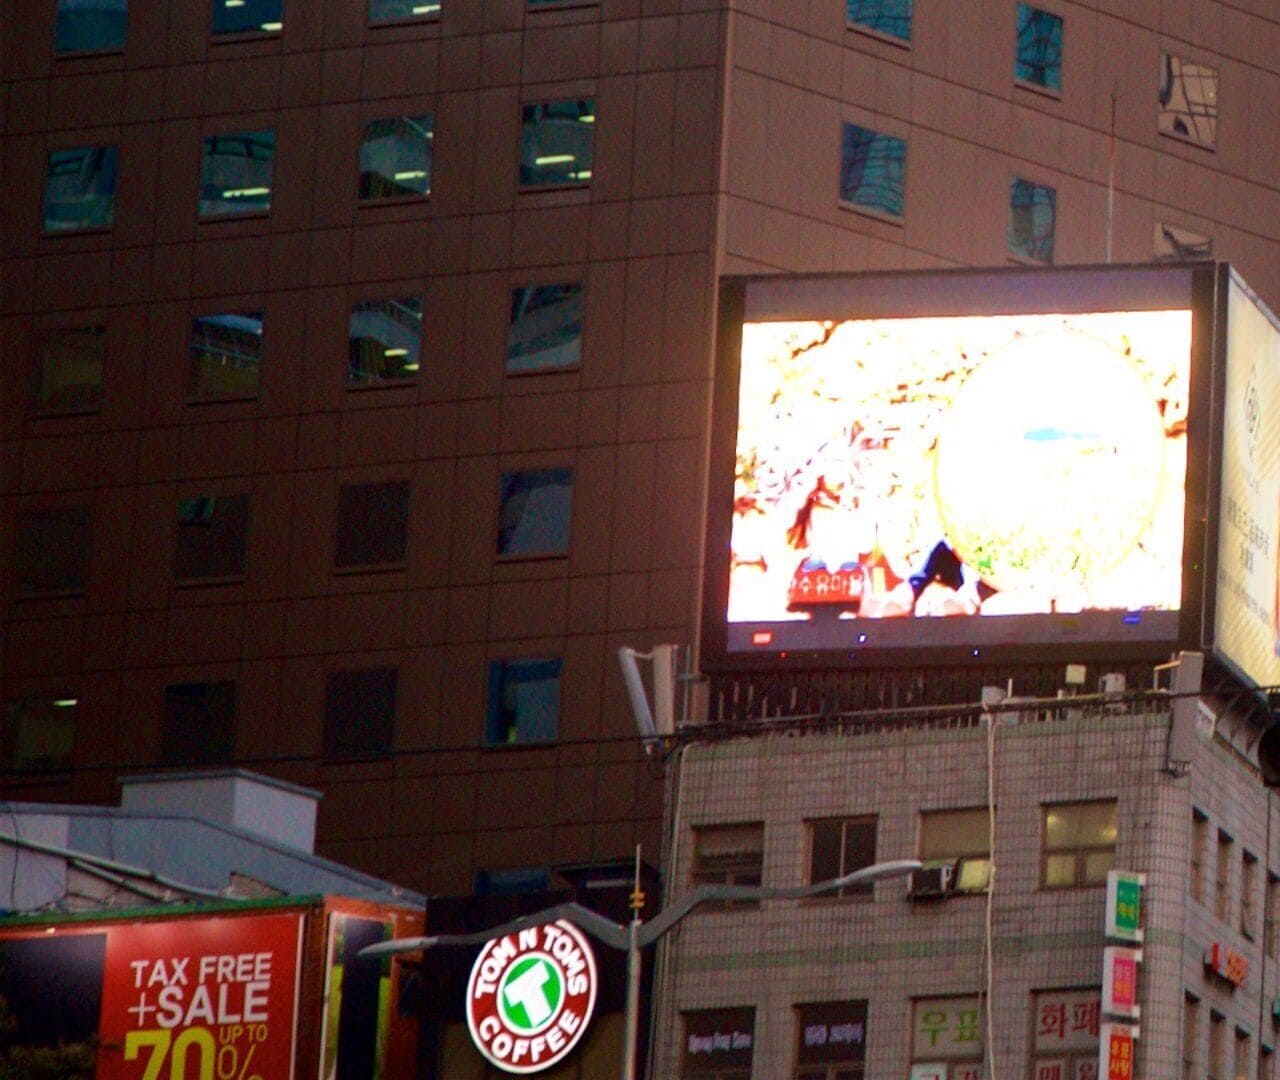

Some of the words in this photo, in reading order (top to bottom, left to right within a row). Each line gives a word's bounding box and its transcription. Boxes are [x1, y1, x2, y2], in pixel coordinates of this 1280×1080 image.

[130, 957, 190, 989] TAX
[199, 952, 273, 984] FREE
[474, 935, 518, 999] TOM
[518, 926, 538, 952] N
[543, 924, 588, 997] TOMS
[219, 1025, 243, 1044] UP
[248, 1023, 268, 1043] TO
[479, 1009, 582, 1064] COFFEE
[921, 1010, 979, 1047] 우표
